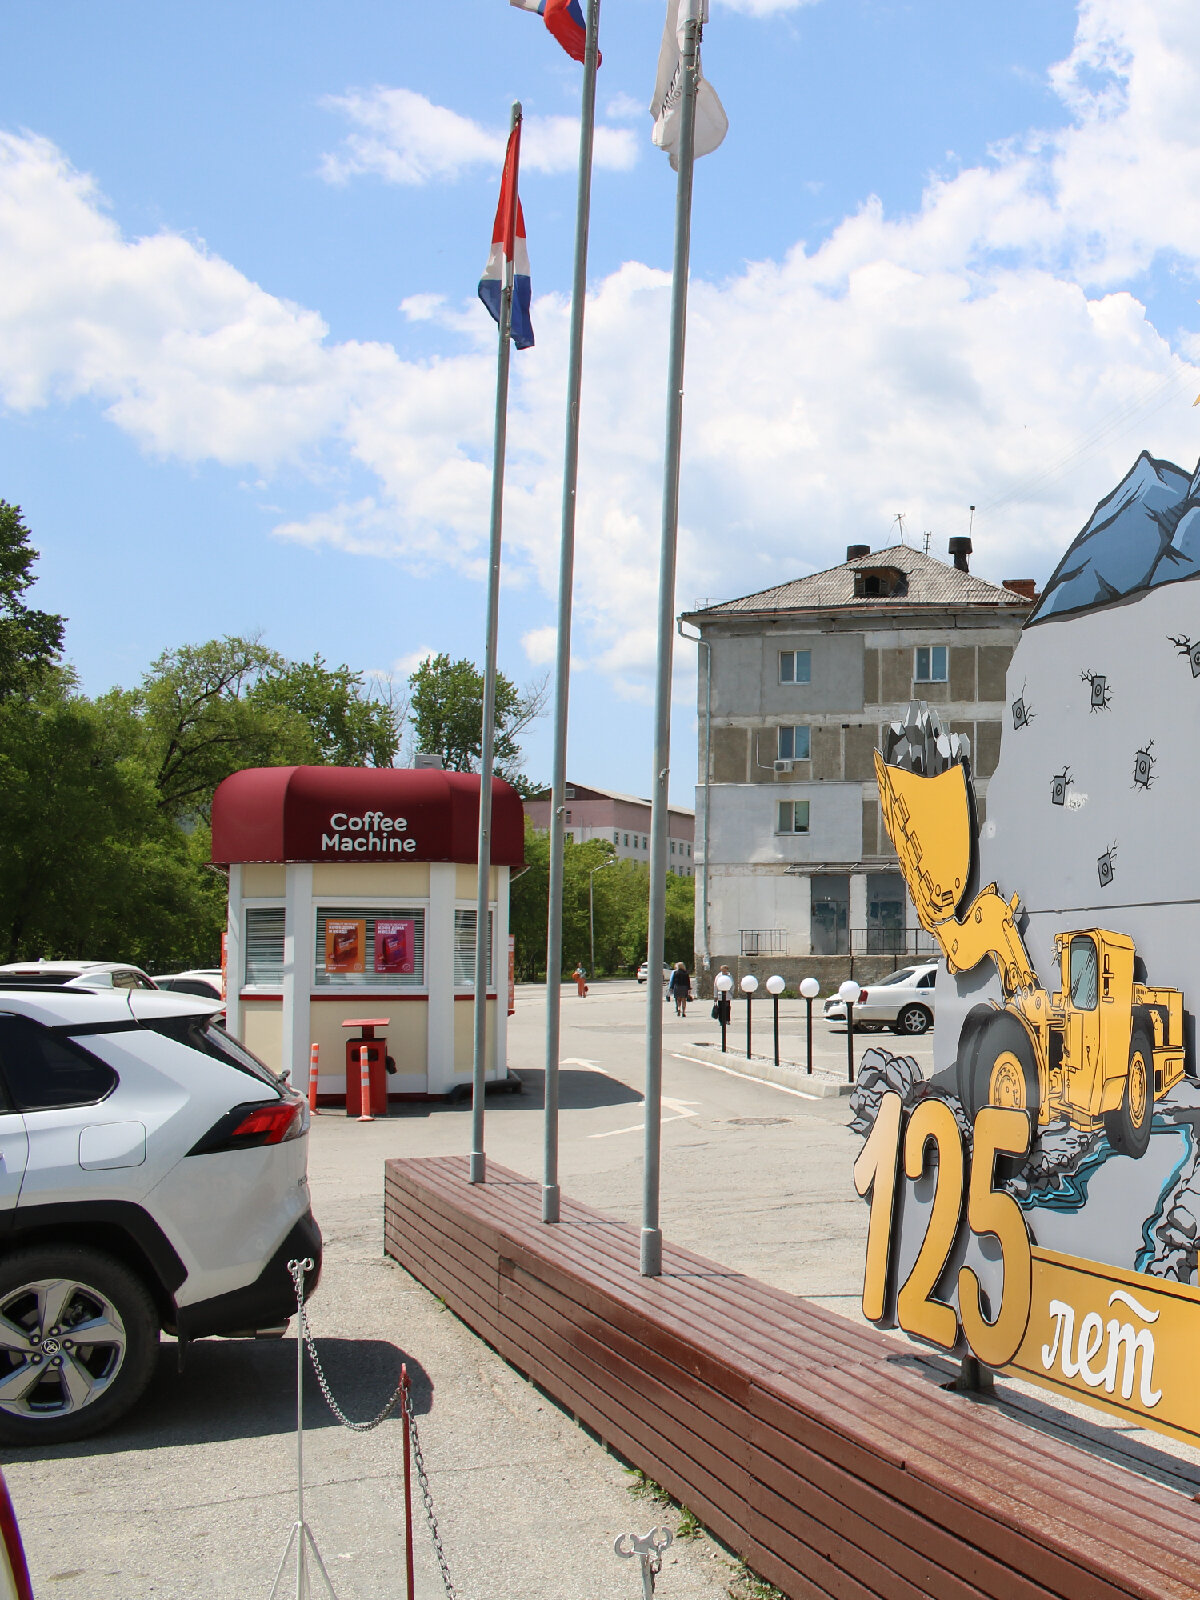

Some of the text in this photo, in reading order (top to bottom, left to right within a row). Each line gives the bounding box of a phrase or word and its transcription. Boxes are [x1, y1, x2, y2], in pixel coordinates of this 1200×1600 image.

[321, 832, 416, 853] Machine
[330, 811, 408, 832] Coffee
[852, 1089, 1033, 1368] 125
[1041, 1289, 1163, 1408] лет
